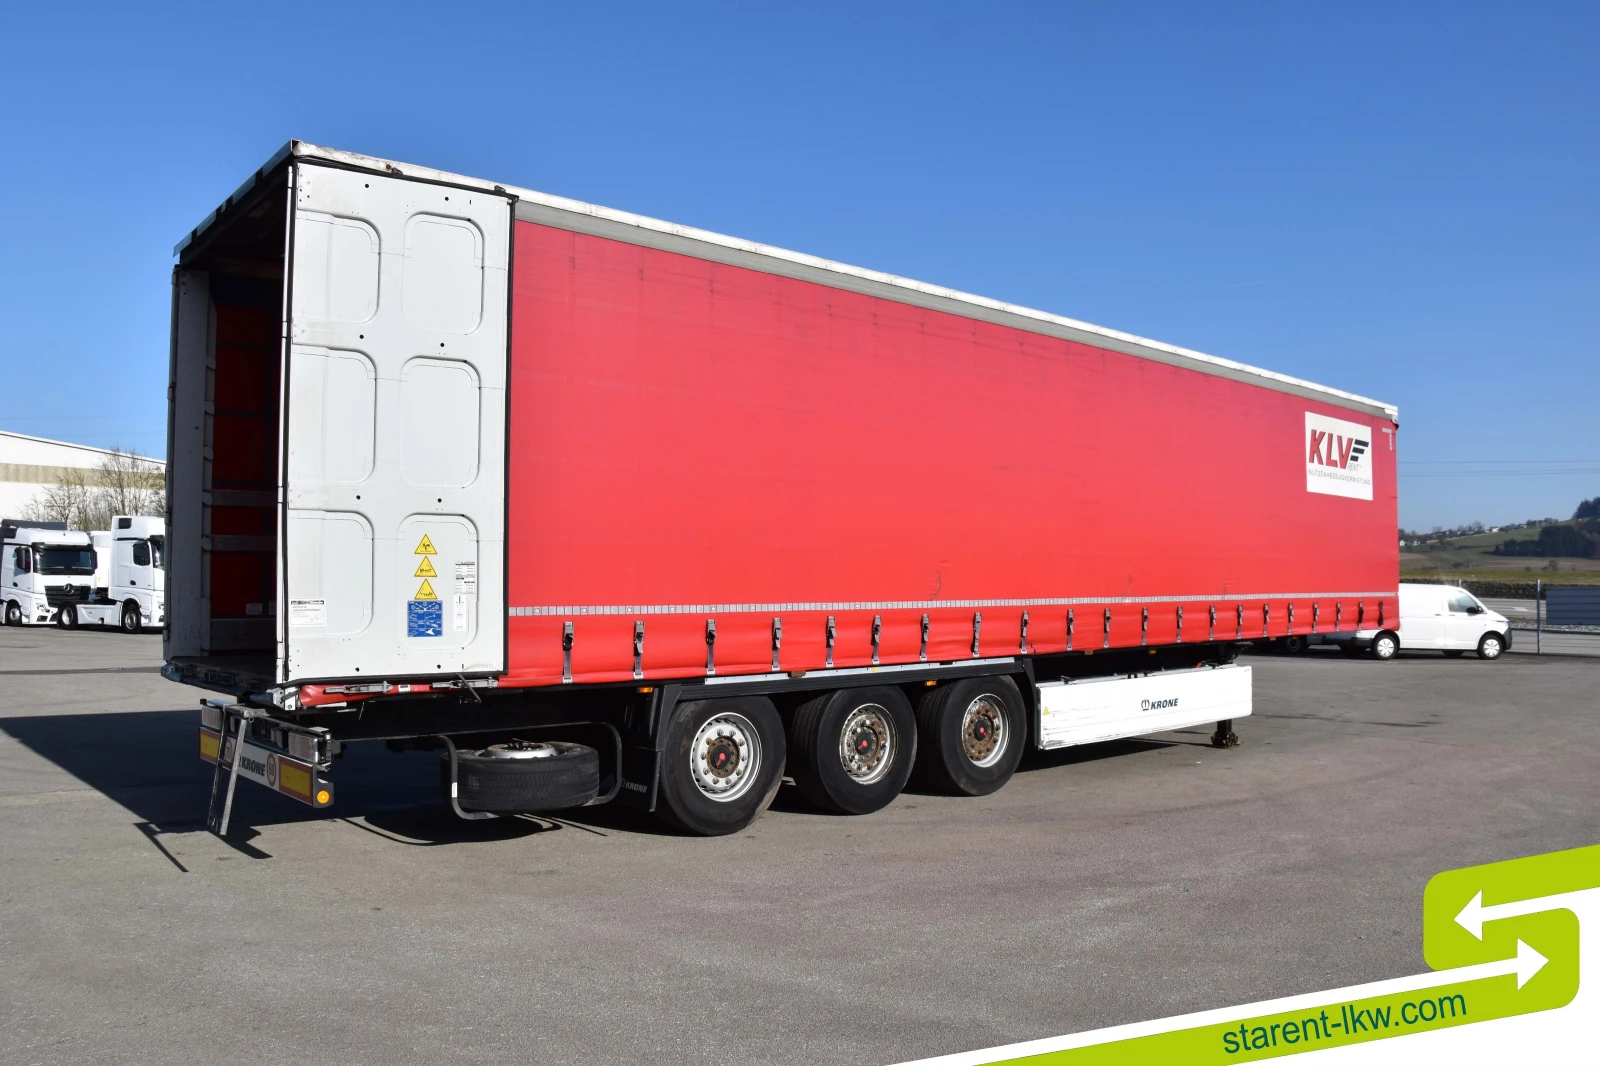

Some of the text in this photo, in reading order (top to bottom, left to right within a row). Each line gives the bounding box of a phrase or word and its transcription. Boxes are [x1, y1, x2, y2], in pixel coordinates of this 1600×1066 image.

[1151, 698, 1178, 710] KRONE
[242, 756, 265, 776] KRONE
[625, 781, 647, 793] KRONE
